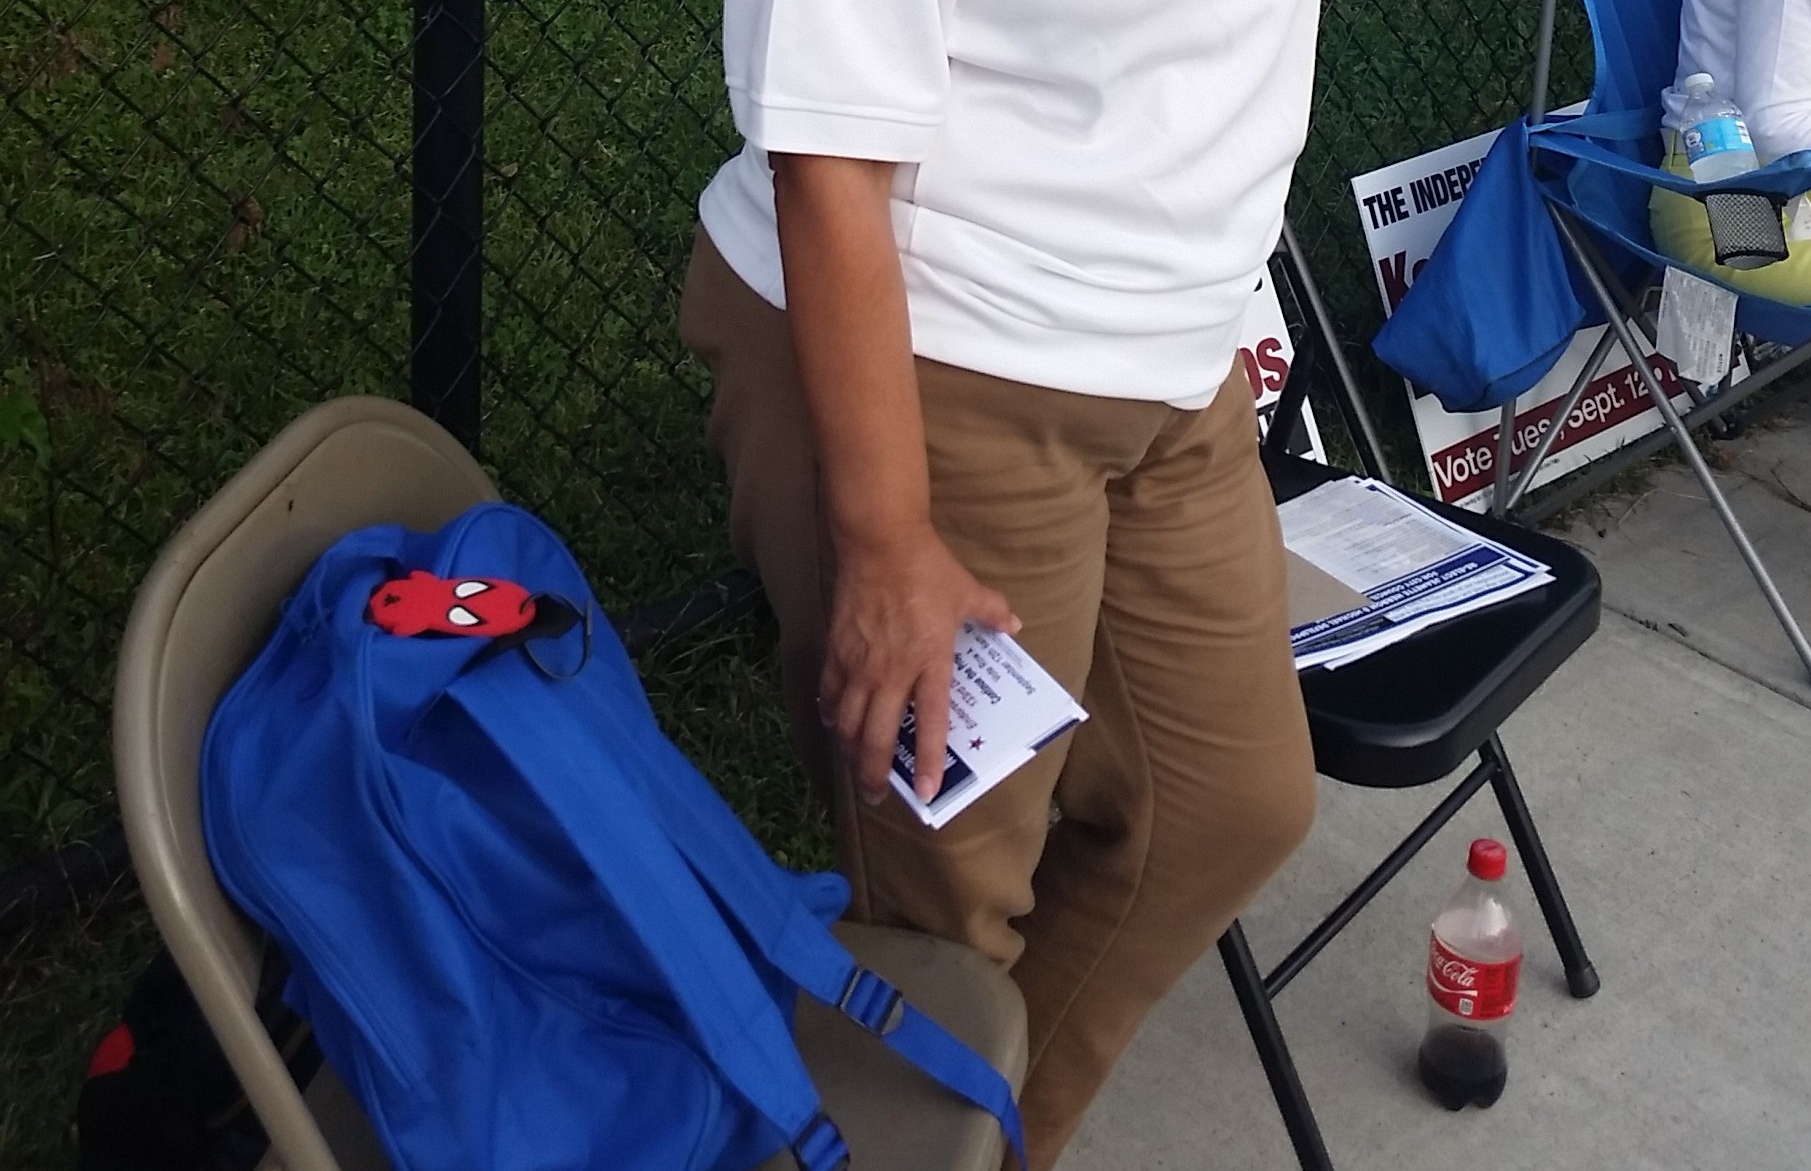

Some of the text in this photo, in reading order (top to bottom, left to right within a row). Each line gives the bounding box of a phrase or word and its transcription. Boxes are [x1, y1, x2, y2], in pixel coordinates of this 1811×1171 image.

[1362, 157, 1487, 230] THE INDEPE
[1433, 446, 1493, 489] Vote
[974, 677, 1001, 704] Continue
